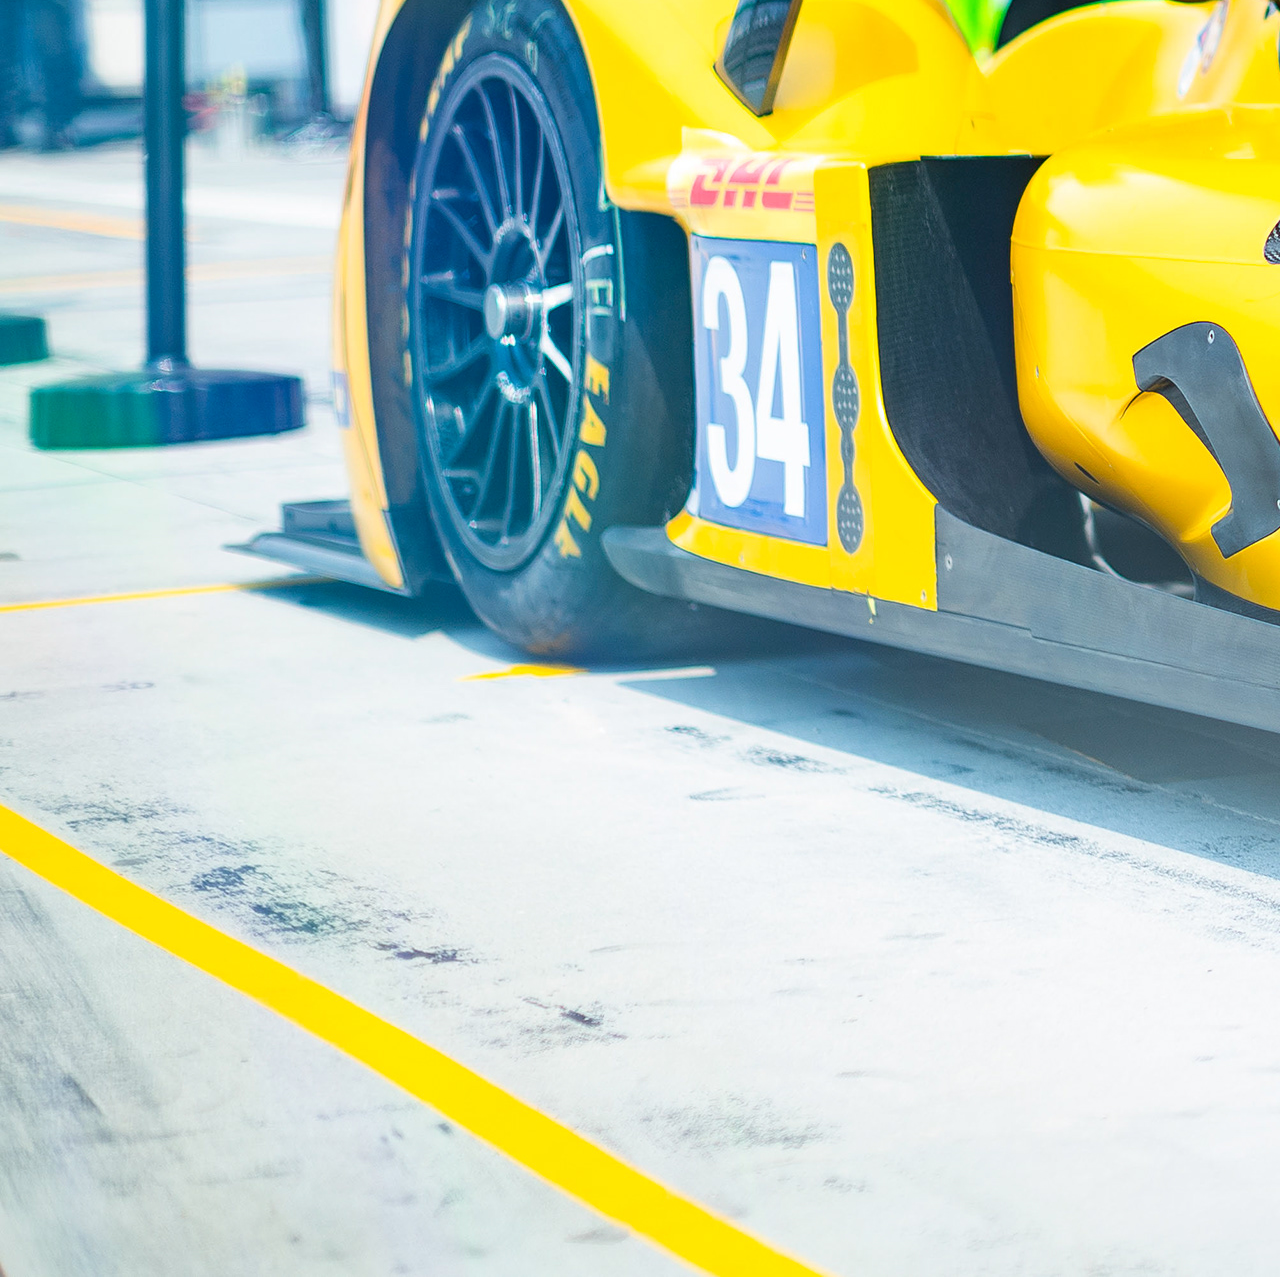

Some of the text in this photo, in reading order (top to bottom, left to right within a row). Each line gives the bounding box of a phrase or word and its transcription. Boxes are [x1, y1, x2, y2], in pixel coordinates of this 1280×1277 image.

[690, 158, 793, 209] DHL
[553, 351, 611, 560] EAGLE
[703, 255, 811, 518] 34
